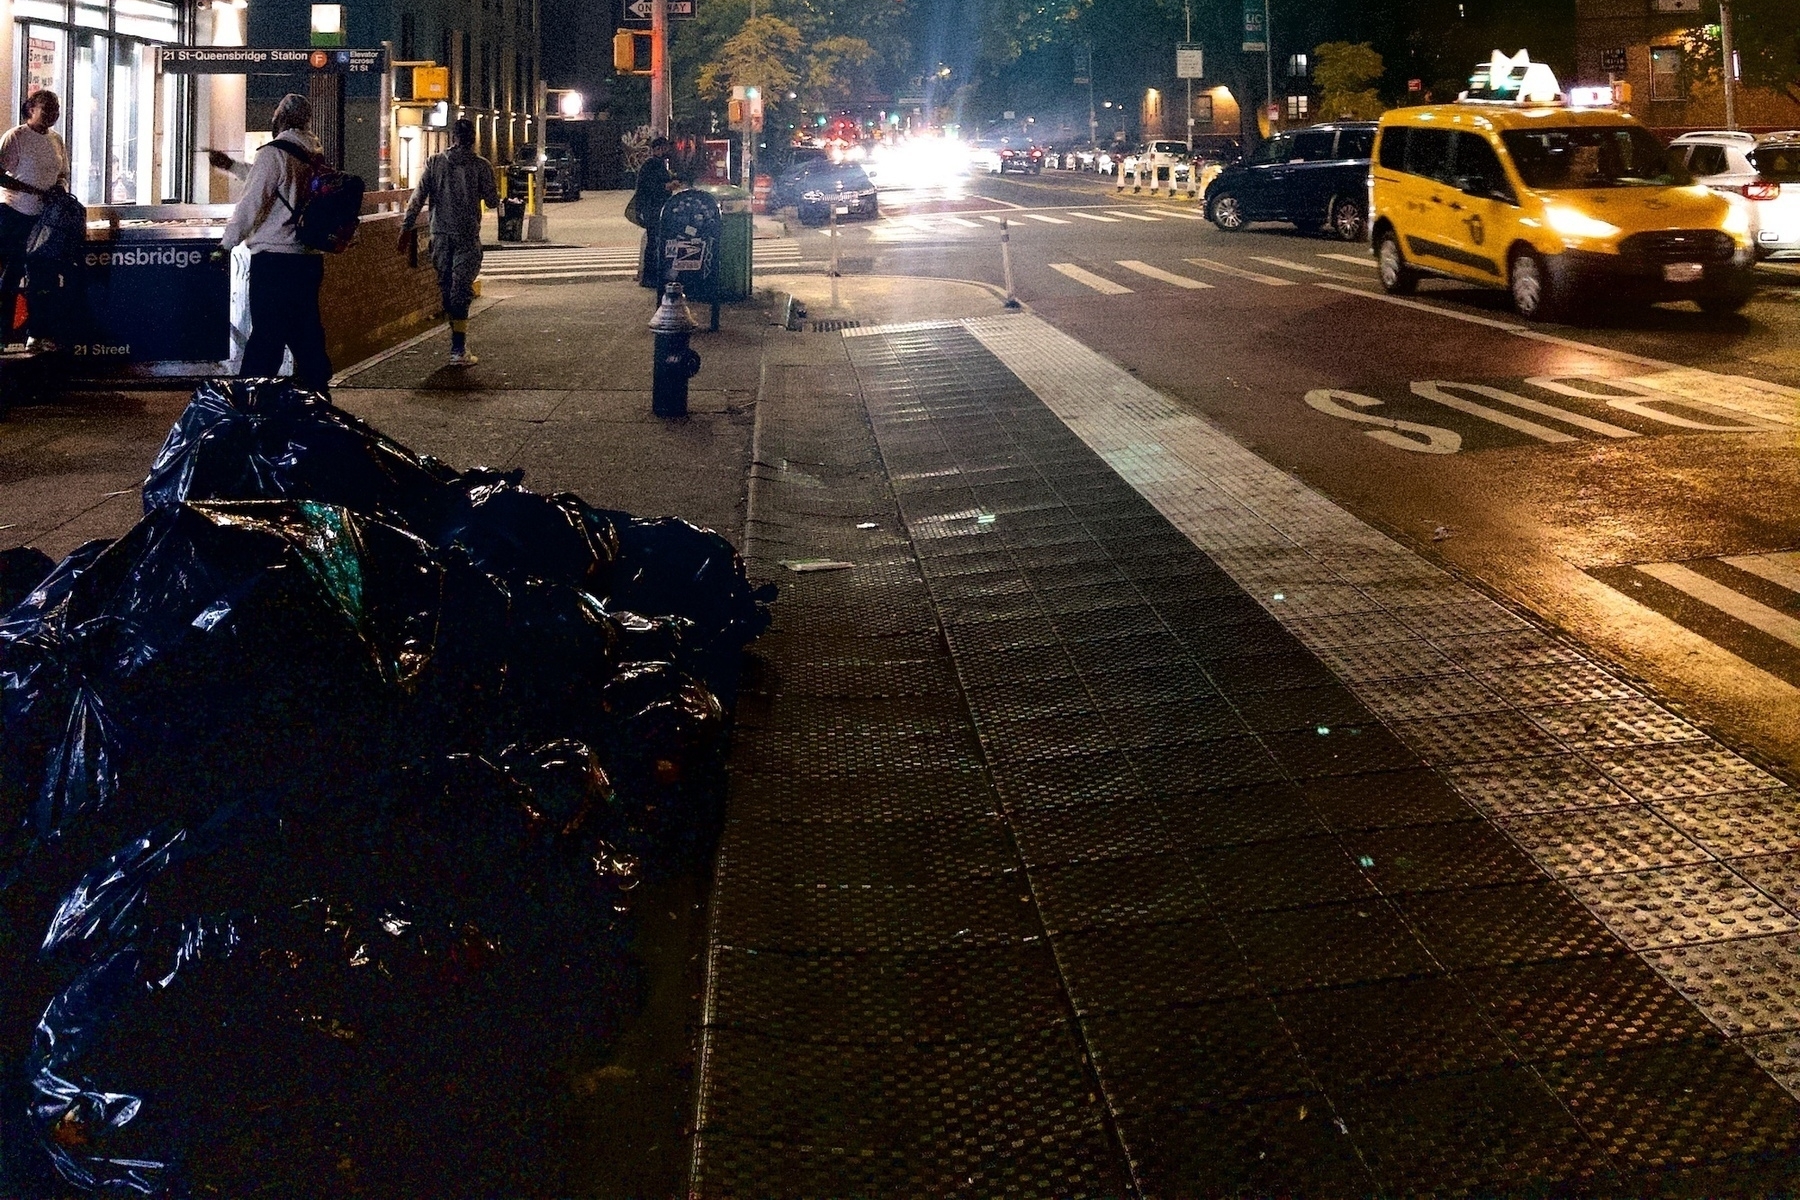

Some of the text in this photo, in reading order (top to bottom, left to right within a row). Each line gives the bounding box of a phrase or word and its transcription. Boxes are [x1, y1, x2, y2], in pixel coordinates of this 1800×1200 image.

[637, 3, 652, 13] ON
[163, 50, 175, 60] 21
[178, 50, 267, 62] St-Queensbridge
[271, 50, 308, 61] Station
[85, 247, 202, 268] eensbridge
[74, 343, 131, 356] 21 Street
[1304, 373, 1790, 455] BUS
